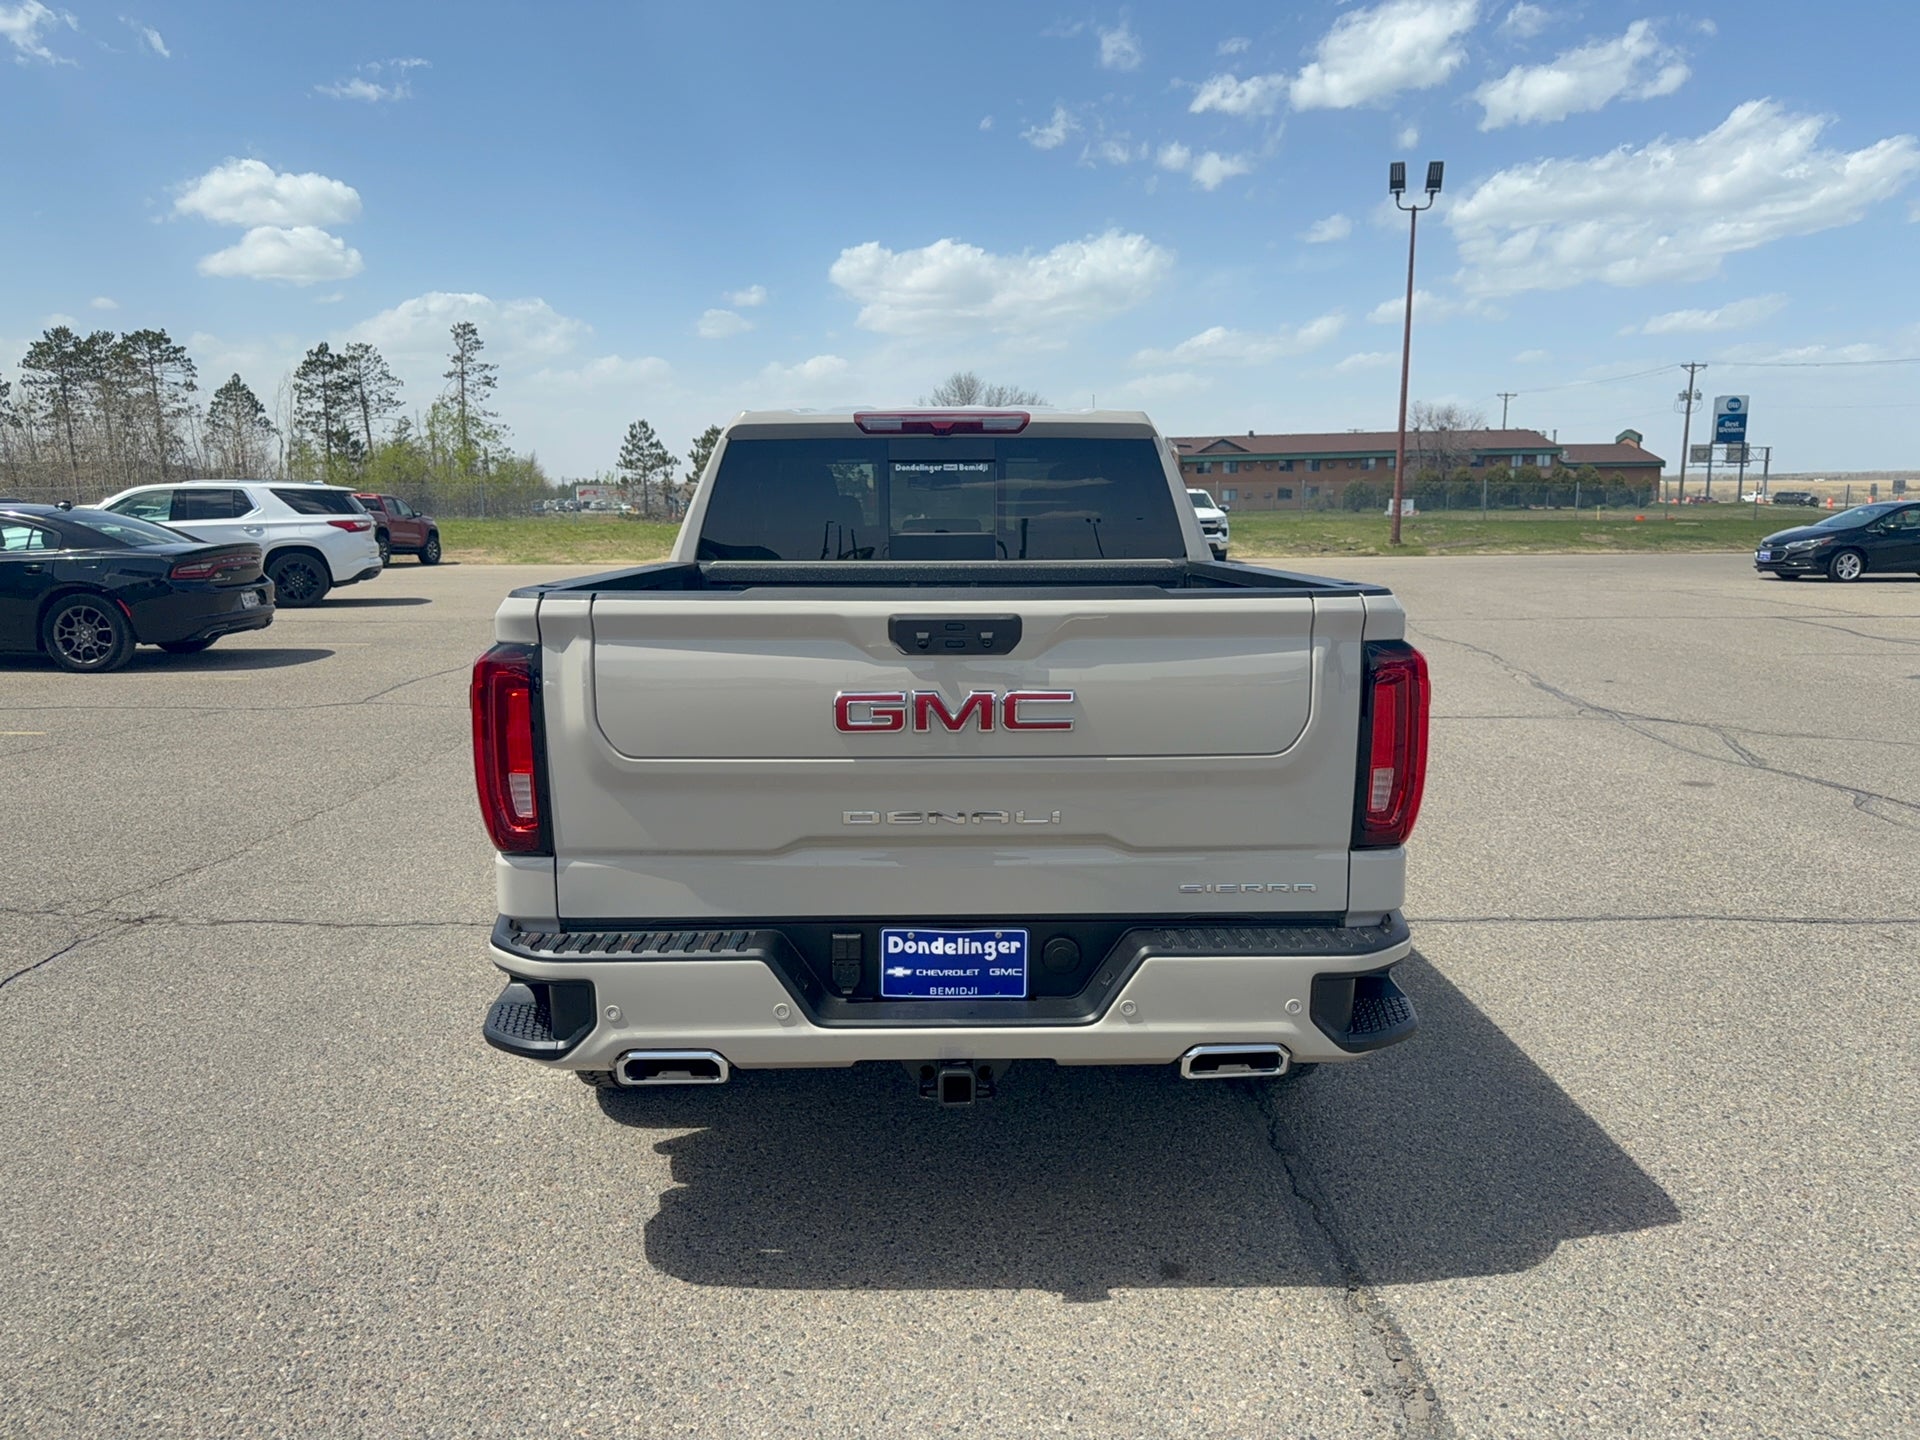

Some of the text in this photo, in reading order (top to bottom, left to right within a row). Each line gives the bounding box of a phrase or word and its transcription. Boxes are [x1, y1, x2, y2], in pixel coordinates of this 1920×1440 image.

[895, 464, 942, 473] Dondelinger
[959, 464, 988, 472] Bemidji
[833, 690, 1075, 734] GMC
[842, 810, 1062, 825] DENALI
[1178, 883, 1318, 894] SIERRA
[887, 936, 1021, 961] Dondelinger
[916, 968, 1023, 976] CHEVROLET GMC
[929, 986, 978, 995] BEMIDJI
